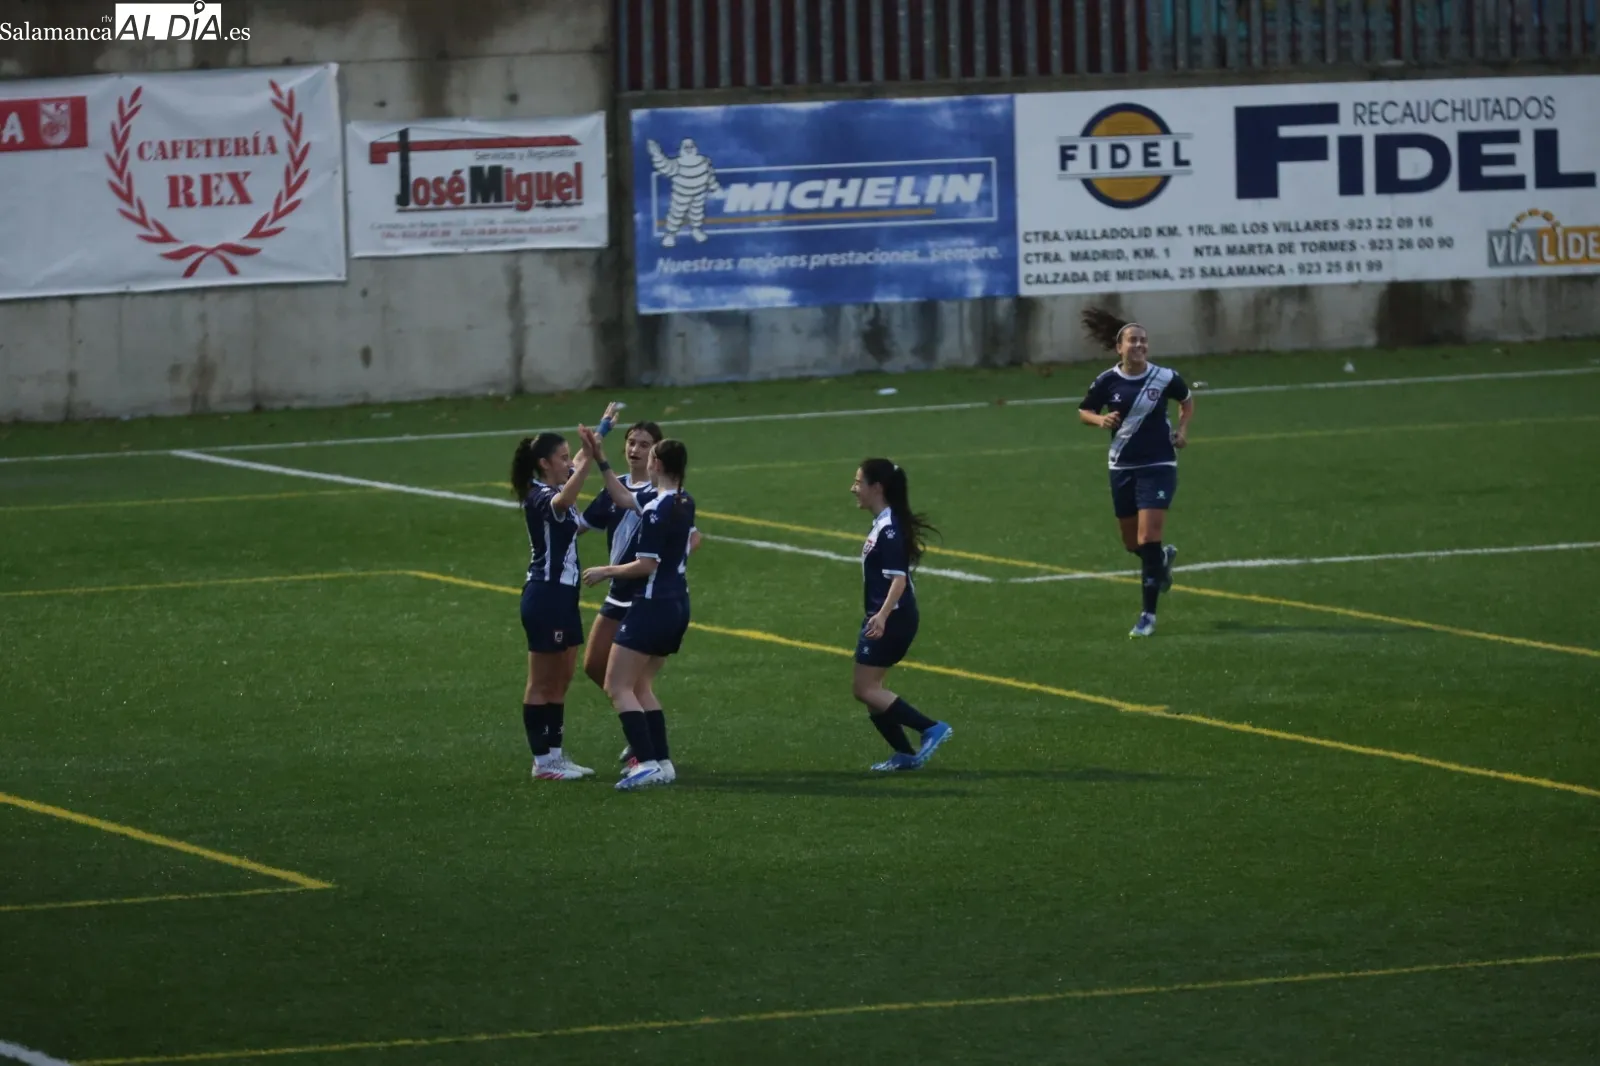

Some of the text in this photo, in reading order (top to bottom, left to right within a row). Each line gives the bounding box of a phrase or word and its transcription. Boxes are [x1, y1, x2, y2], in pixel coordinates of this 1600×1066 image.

[1353, 96, 1556, 126] RECAUCHUTADOS
[136, 131, 279, 162] CAFETERÍA
[1059, 140, 1191, 172] FIDEL
[1234, 102, 1597, 200] FIDEL
[166, 171, 253, 209] REX
[396, 140, 583, 211] José Miguel
[723, 173, 984, 213] MICHELIN
[1064, 226, 1153, 241] VALLADOLID
[1241, 221, 1269, 234] LOS
[1272, 219, 1340, 233] VILLARES
[1225, 243, 1273, 256] MARTA
[1277, 242, 1296, 255] DE
[1300, 240, 1357, 254] TORMES
[656, 256, 735, 274] Nuestras
[1023, 271, 1089, 286] CALZADA
[1093, 270, 1112, 283] DE
[1199, 263, 1286, 279] SALAMANCA
